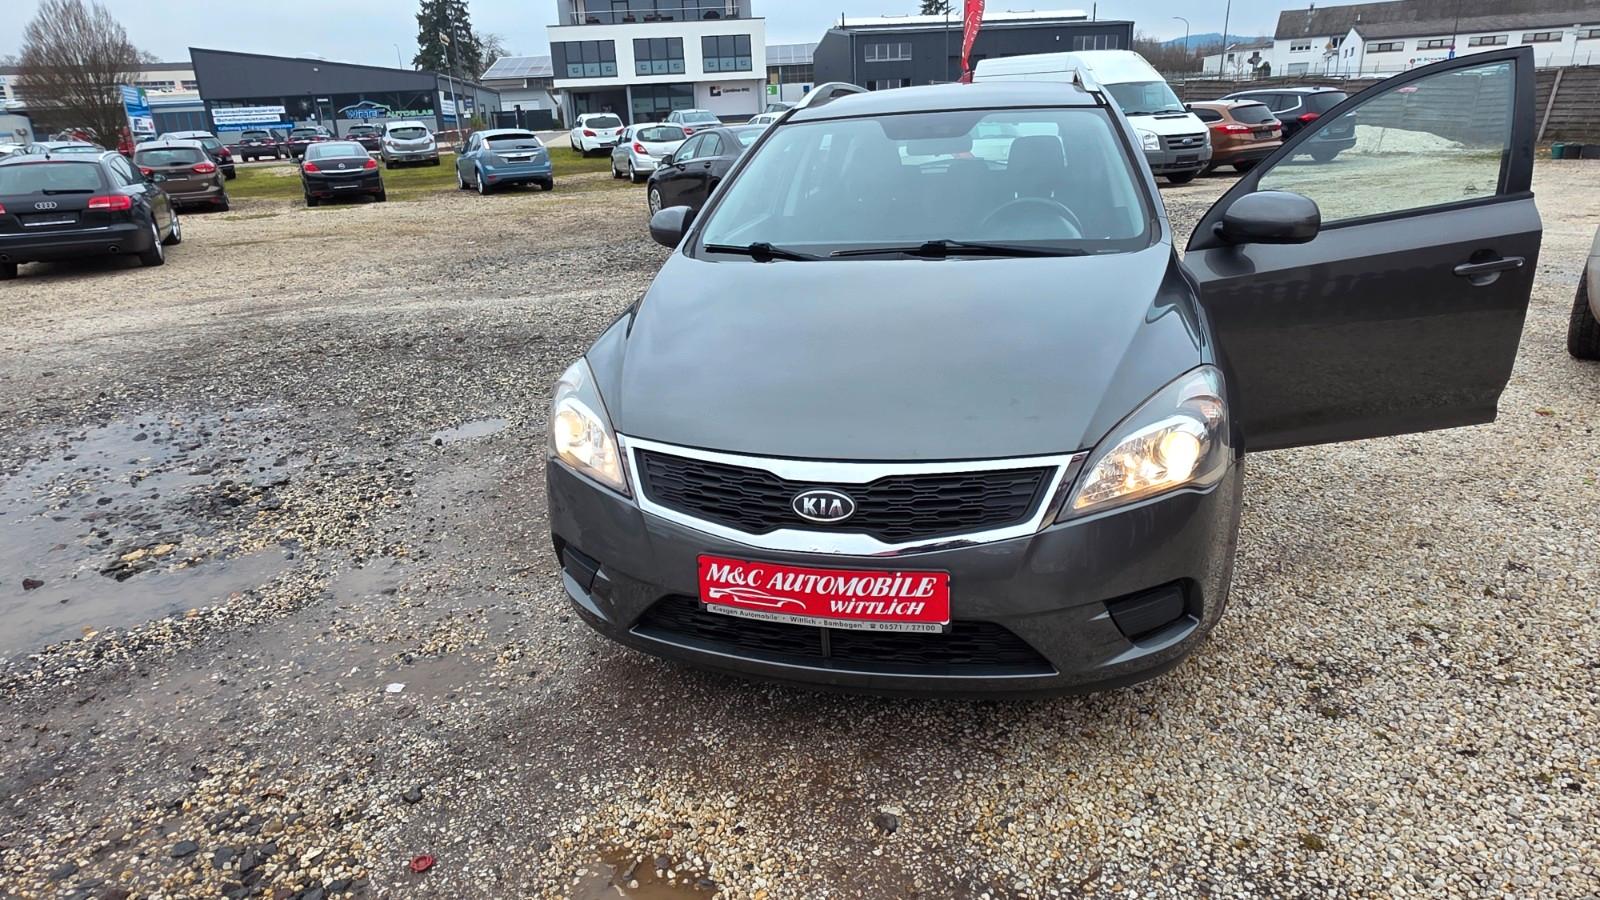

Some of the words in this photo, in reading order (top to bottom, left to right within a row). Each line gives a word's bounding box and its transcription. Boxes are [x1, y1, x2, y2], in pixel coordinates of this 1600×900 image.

[803, 498, 844, 515] KIA
[706, 563, 764, 587] M&C
[739, 611, 778, 621] Automobile
[790, 616, 816, 625] Wittlich
